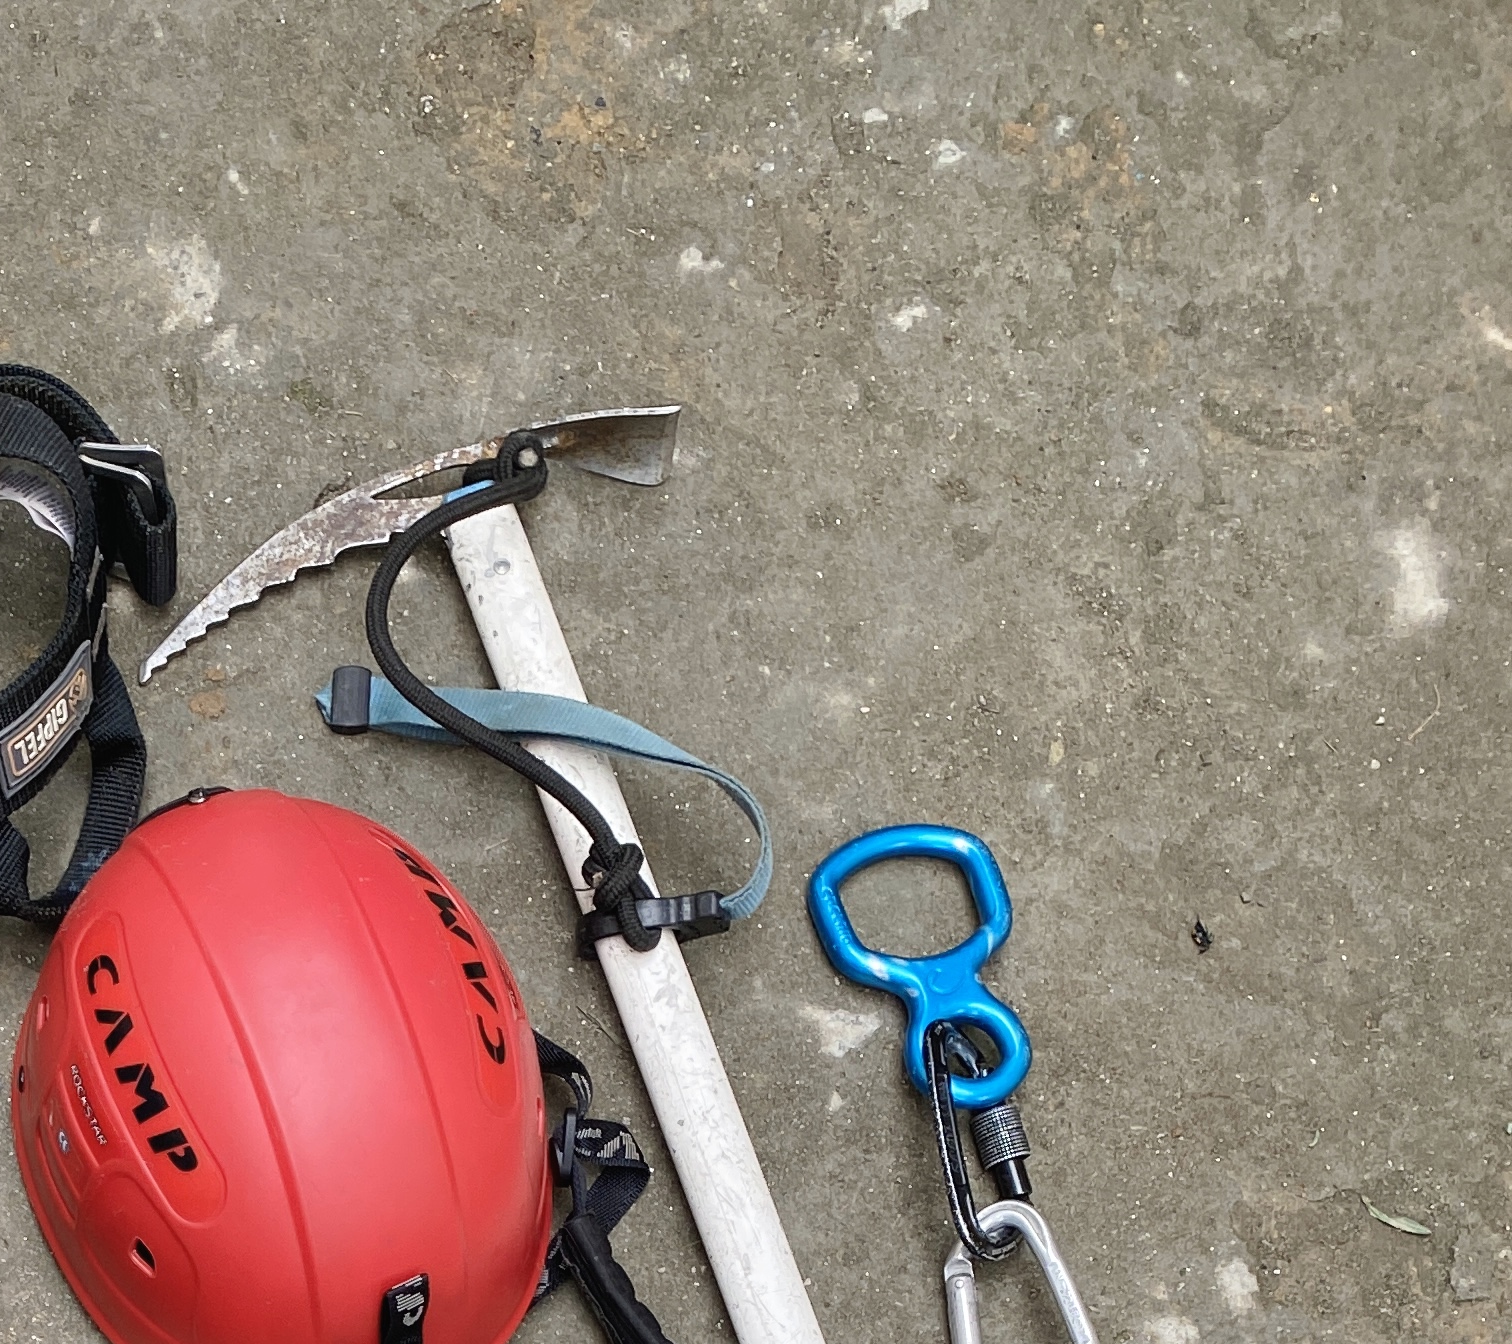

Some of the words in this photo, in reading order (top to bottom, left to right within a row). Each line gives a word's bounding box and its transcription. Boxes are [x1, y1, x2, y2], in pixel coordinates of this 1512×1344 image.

[14, 698, 69, 765] GIPFEL
[393, 847, 506, 1065] CAMP
[70, 1064, 108, 1146] ROCKSTAR
[87, 955, 199, 1173] CAMP
